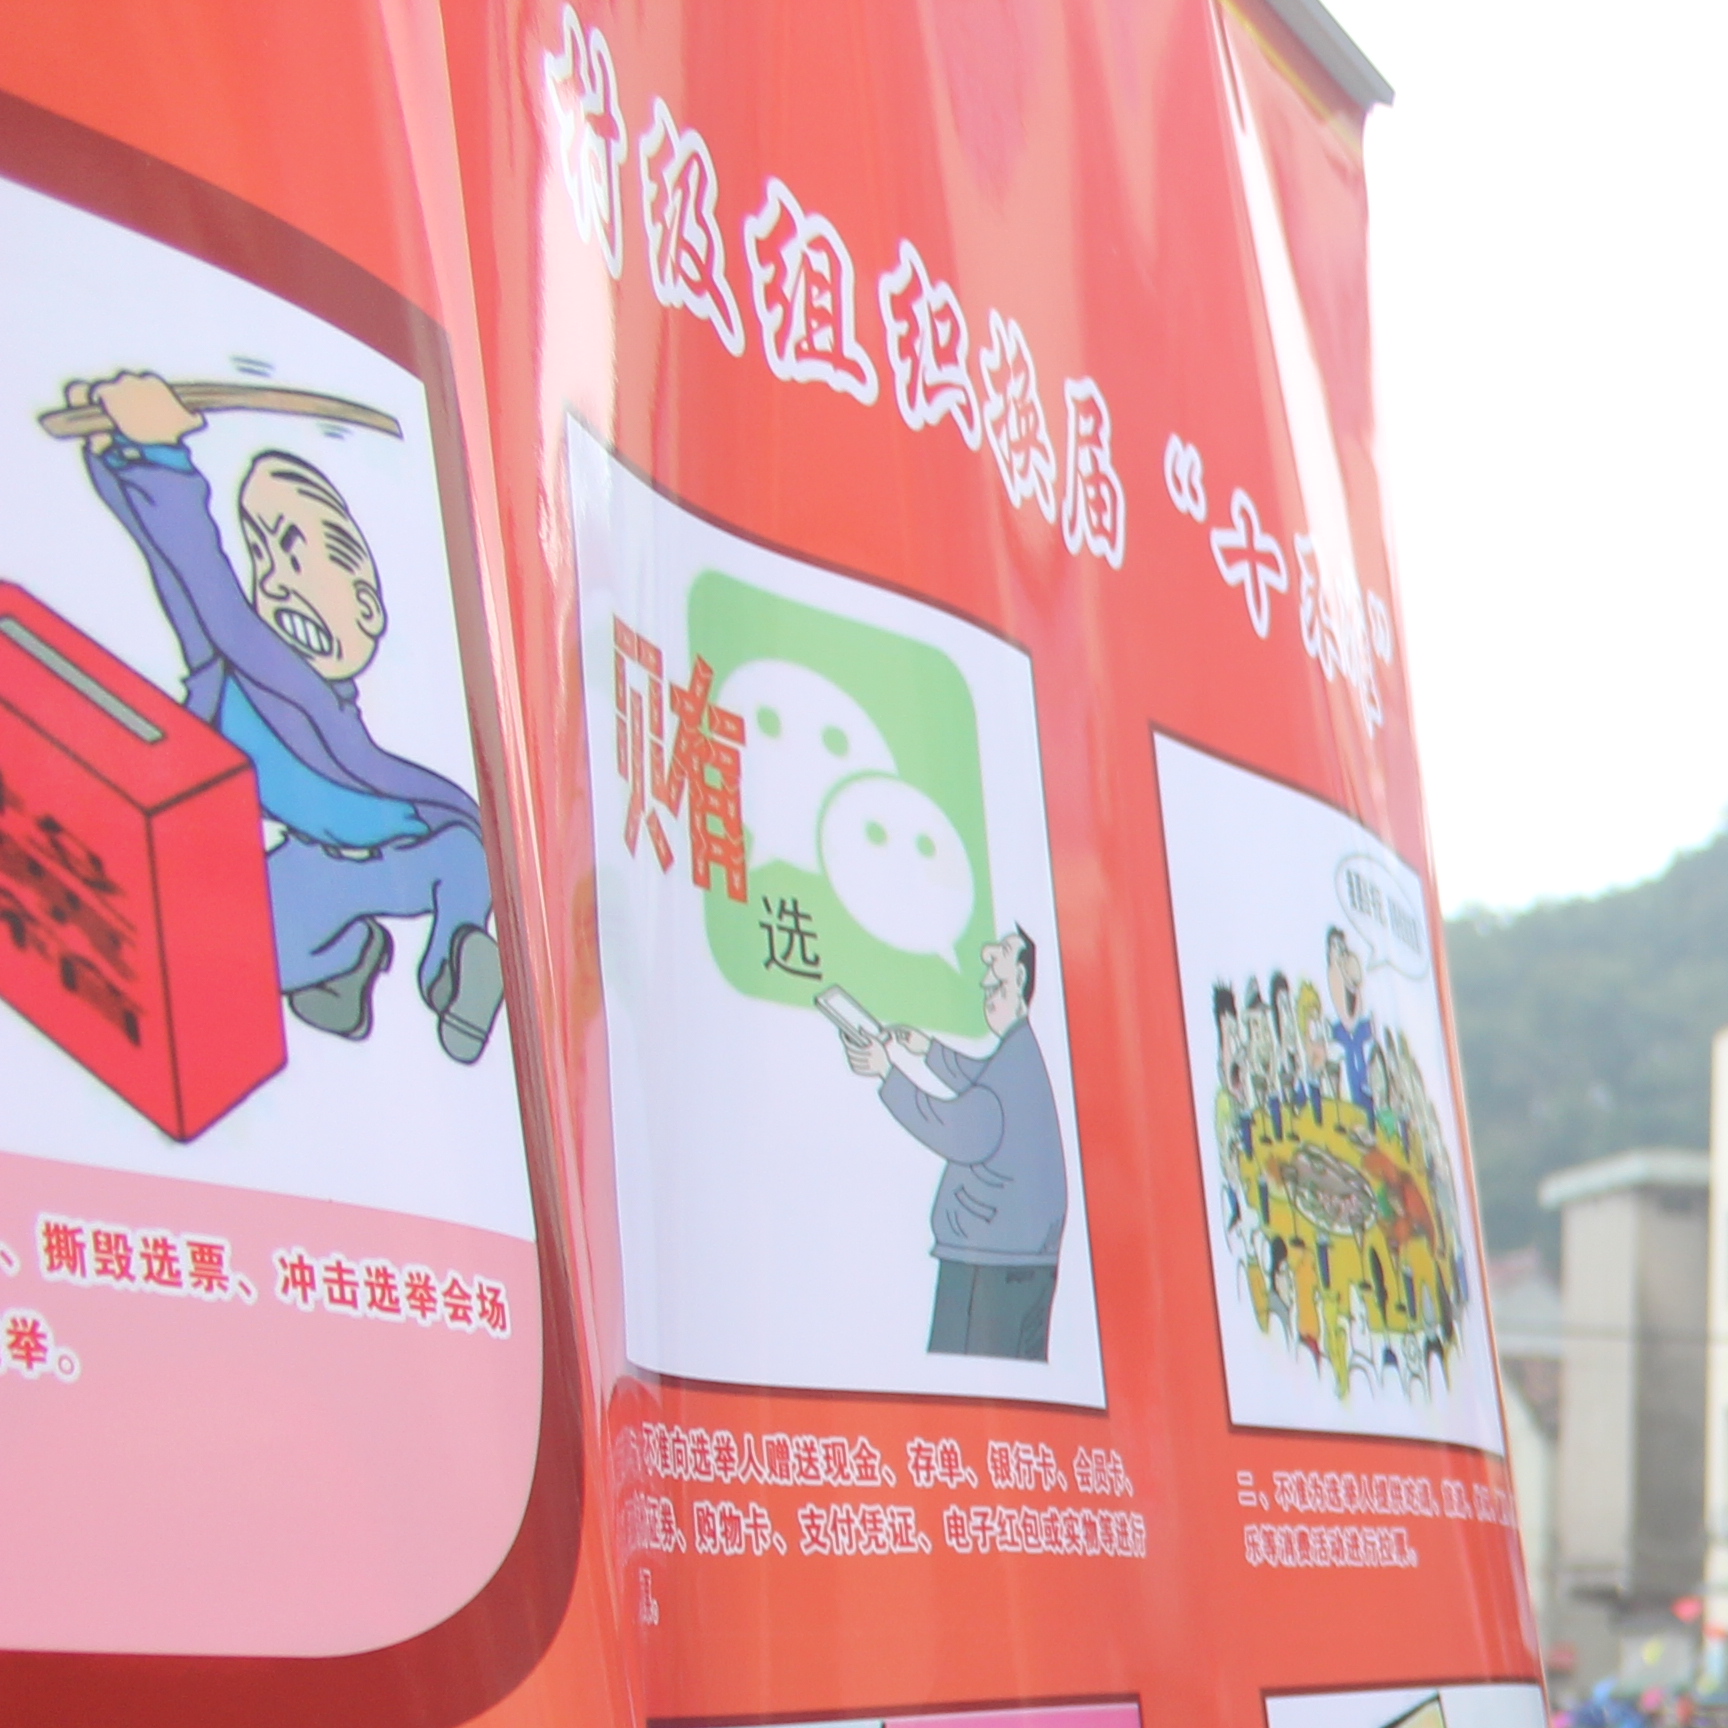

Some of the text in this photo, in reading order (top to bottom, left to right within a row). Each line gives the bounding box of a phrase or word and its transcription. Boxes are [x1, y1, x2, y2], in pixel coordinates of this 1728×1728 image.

[612, 613, 748, 904] 贿
[757, 895, 823, 981] 选
[6, 1316, 75, 1371] 举。
[622, 1496, 1147, 1558] 证券、购物卡、支付凭证、电子红包或实物等进行
